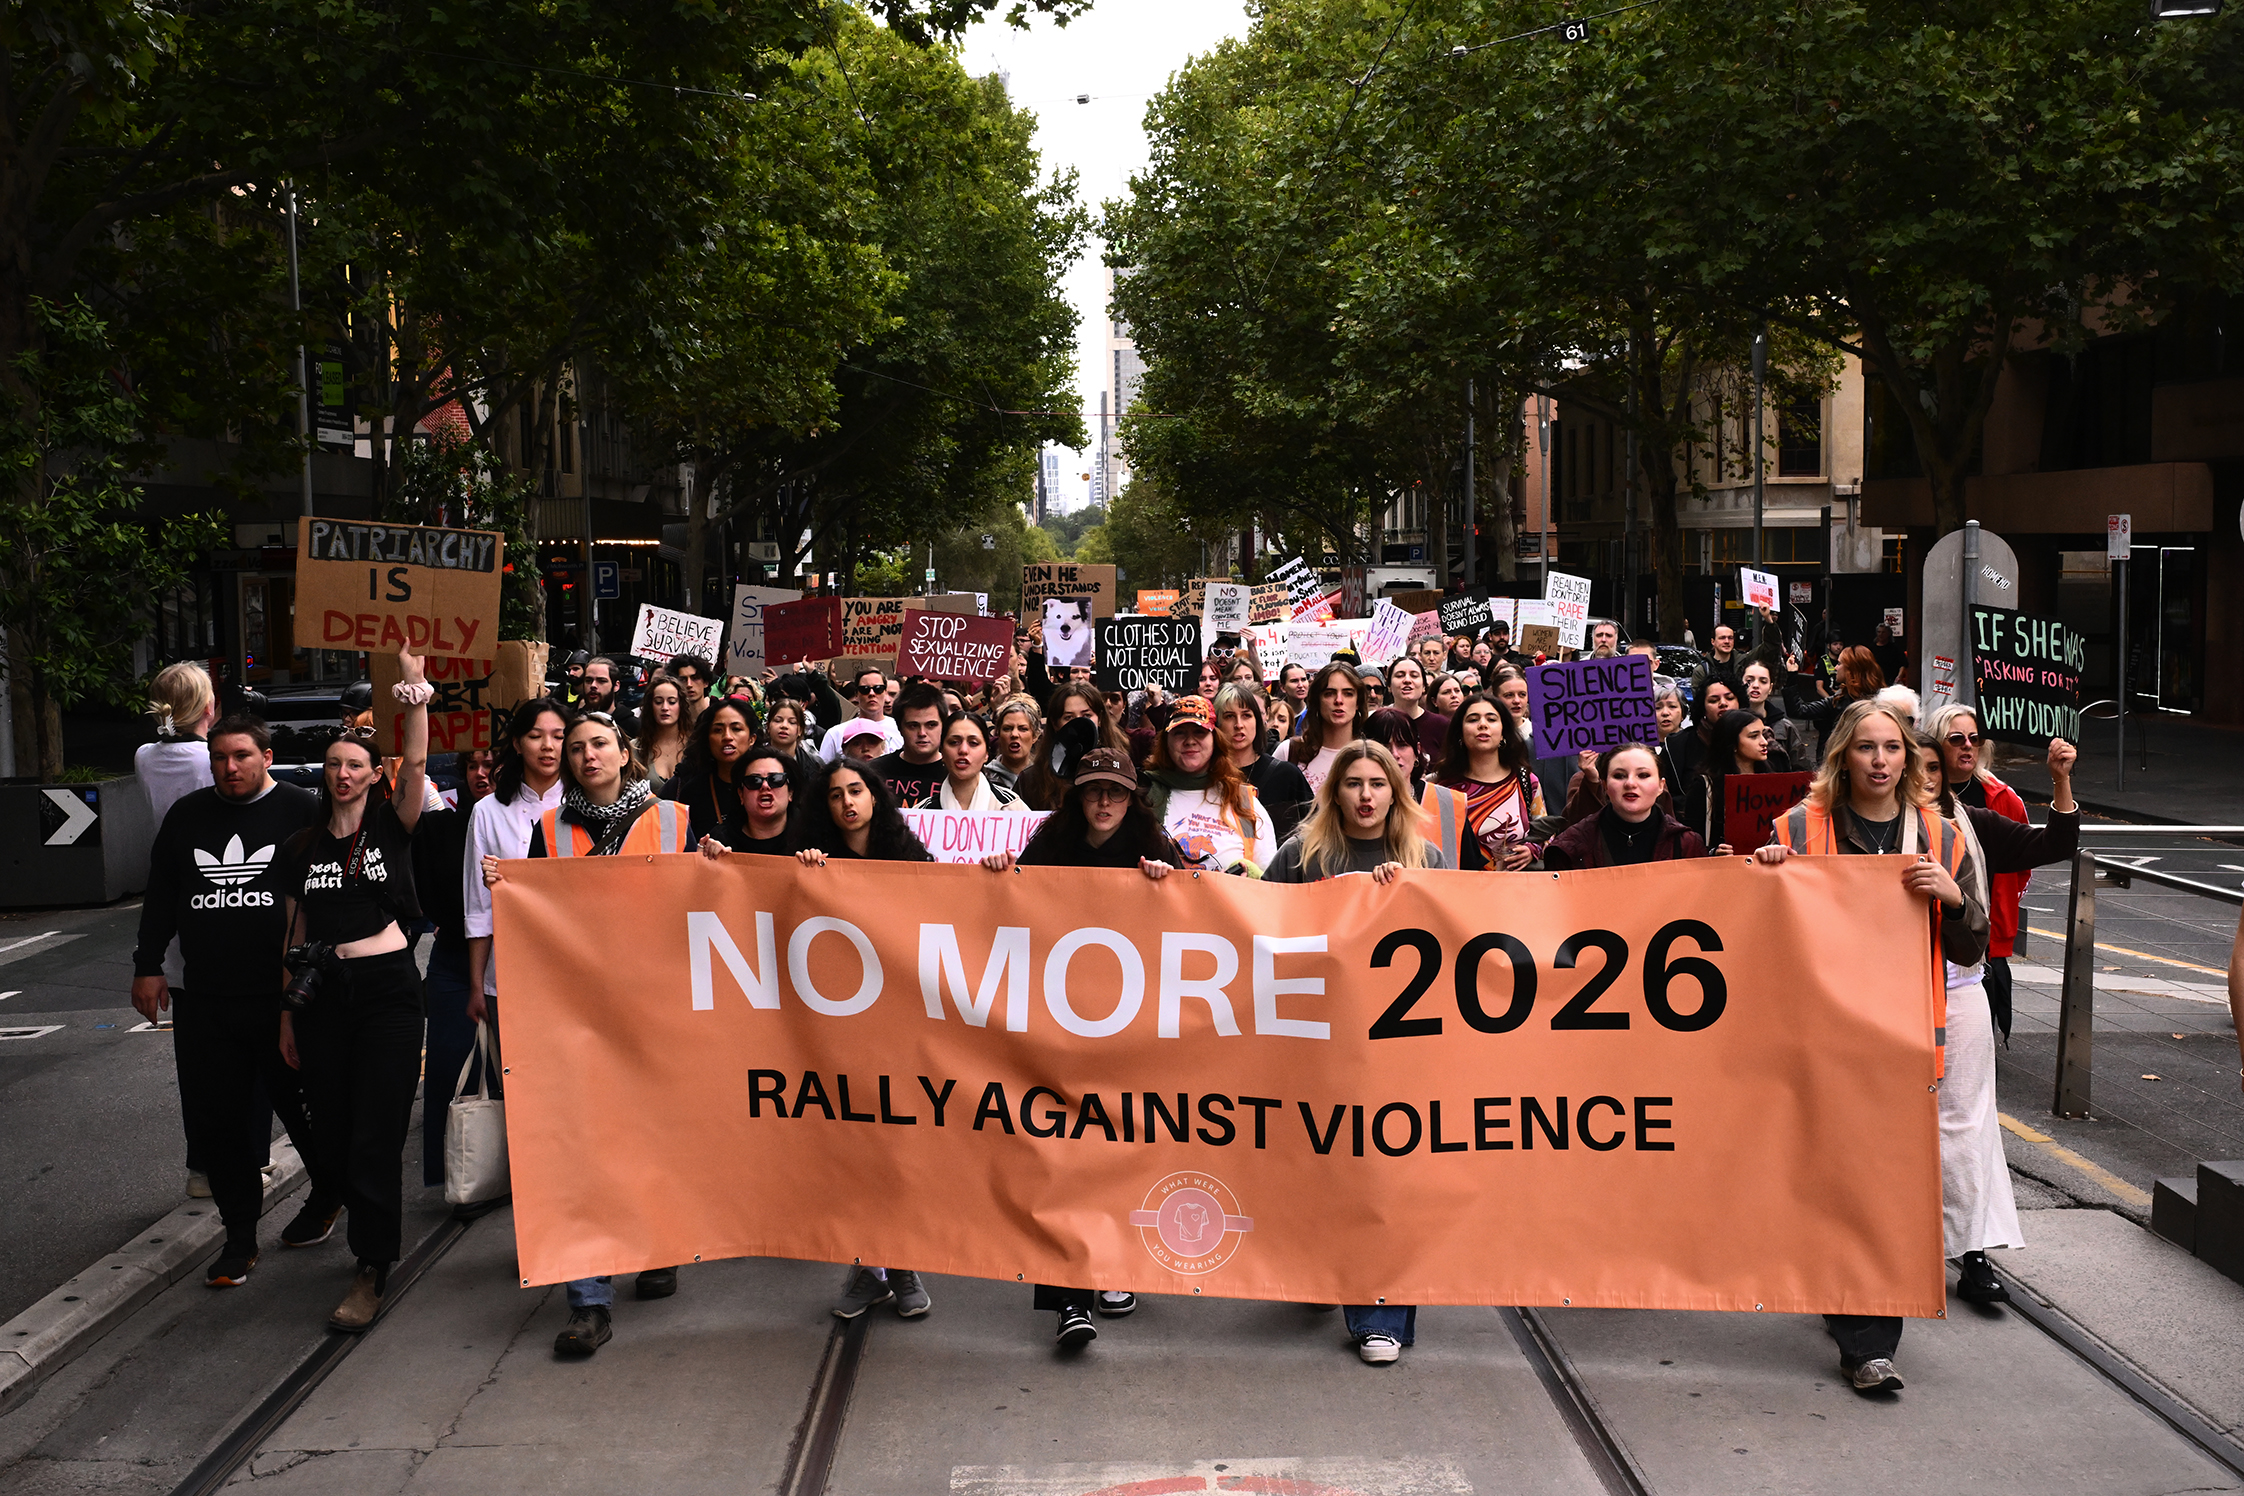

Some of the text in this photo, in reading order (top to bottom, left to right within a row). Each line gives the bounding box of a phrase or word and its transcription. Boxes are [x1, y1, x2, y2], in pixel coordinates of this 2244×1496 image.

[1566, 23, 1585, 40] 61
[310, 523, 495, 571] PATRIARCHY
[1412, 548, 1422, 559] P
[598, 566, 613, 585] P
[1024, 566, 1078, 585] EVEN HE
[1266, 561, 1307, 584] WOMEN
[370, 567, 412, 603] IS
[1023, 582, 1102, 598] UNDERSTANDS
[1298, 584, 1319, 600] SHIT
[1553, 576, 1589, 594] REAL MEN
[741, 596, 769, 619] ST
[845, 601, 872, 619] YOU
[876, 601, 903, 615] ARE
[1443, 596, 1477, 614] SURVIVAL
[1558, 601, 1584, 620] RAPE
[657, 614, 713, 641] BELIEVE
[851, 627, 873, 636] ARE
[856, 614, 897, 627] ANGRY
[915, 616, 967, 639] STOP
[1217, 621, 1231, 629] ME
[1446, 612, 1487, 632] SOUND LOUD
[1551, 615, 1578, 632] THEIR
[322, 610, 480, 655] DEADLY
[843, 635, 881, 645] PAYING
[1104, 622, 1195, 647] CLOTHES DO
[1532, 629, 1554, 638] WOMEN
[1535, 637, 1547, 645] ARE
[1975, 611, 2005, 651] IF
[2015, 616, 2063, 662] SHE
[2063, 625, 2085, 673] WAS
[643, 629, 713, 662] SURVIVORS
[908, 638, 1004, 660] SEXUALIZING
[911, 656, 998, 678] VIOLENCE
[1106, 647, 1192, 668] NOT EQUAL
[1119, 668, 1189, 690] CONSENT
[1540, 663, 1648, 701] SILENCE
[2041, 670, 2063, 688] FOR
[1544, 697, 1656, 728] PROTECTS
[1980, 696, 2025, 731] WHY
[1541, 723, 1658, 751] VIOLENCE
[1188, 819, 1200, 827] YOU
[942, 815, 1002, 854] DON'T
[349, 857, 359, 875] EOS
[354, 847, 362, 857] 5D
[190, 888, 275, 910] adidas
[687, 911, 1728, 1041] NO MORE 2026
[746, 1068, 1675, 1158] RALLY AGAINST VIOLENCE
[1161, 1177, 1220, 1195] WHAT WERE
[1152, 1243, 1222, 1271] YOU WEARING
